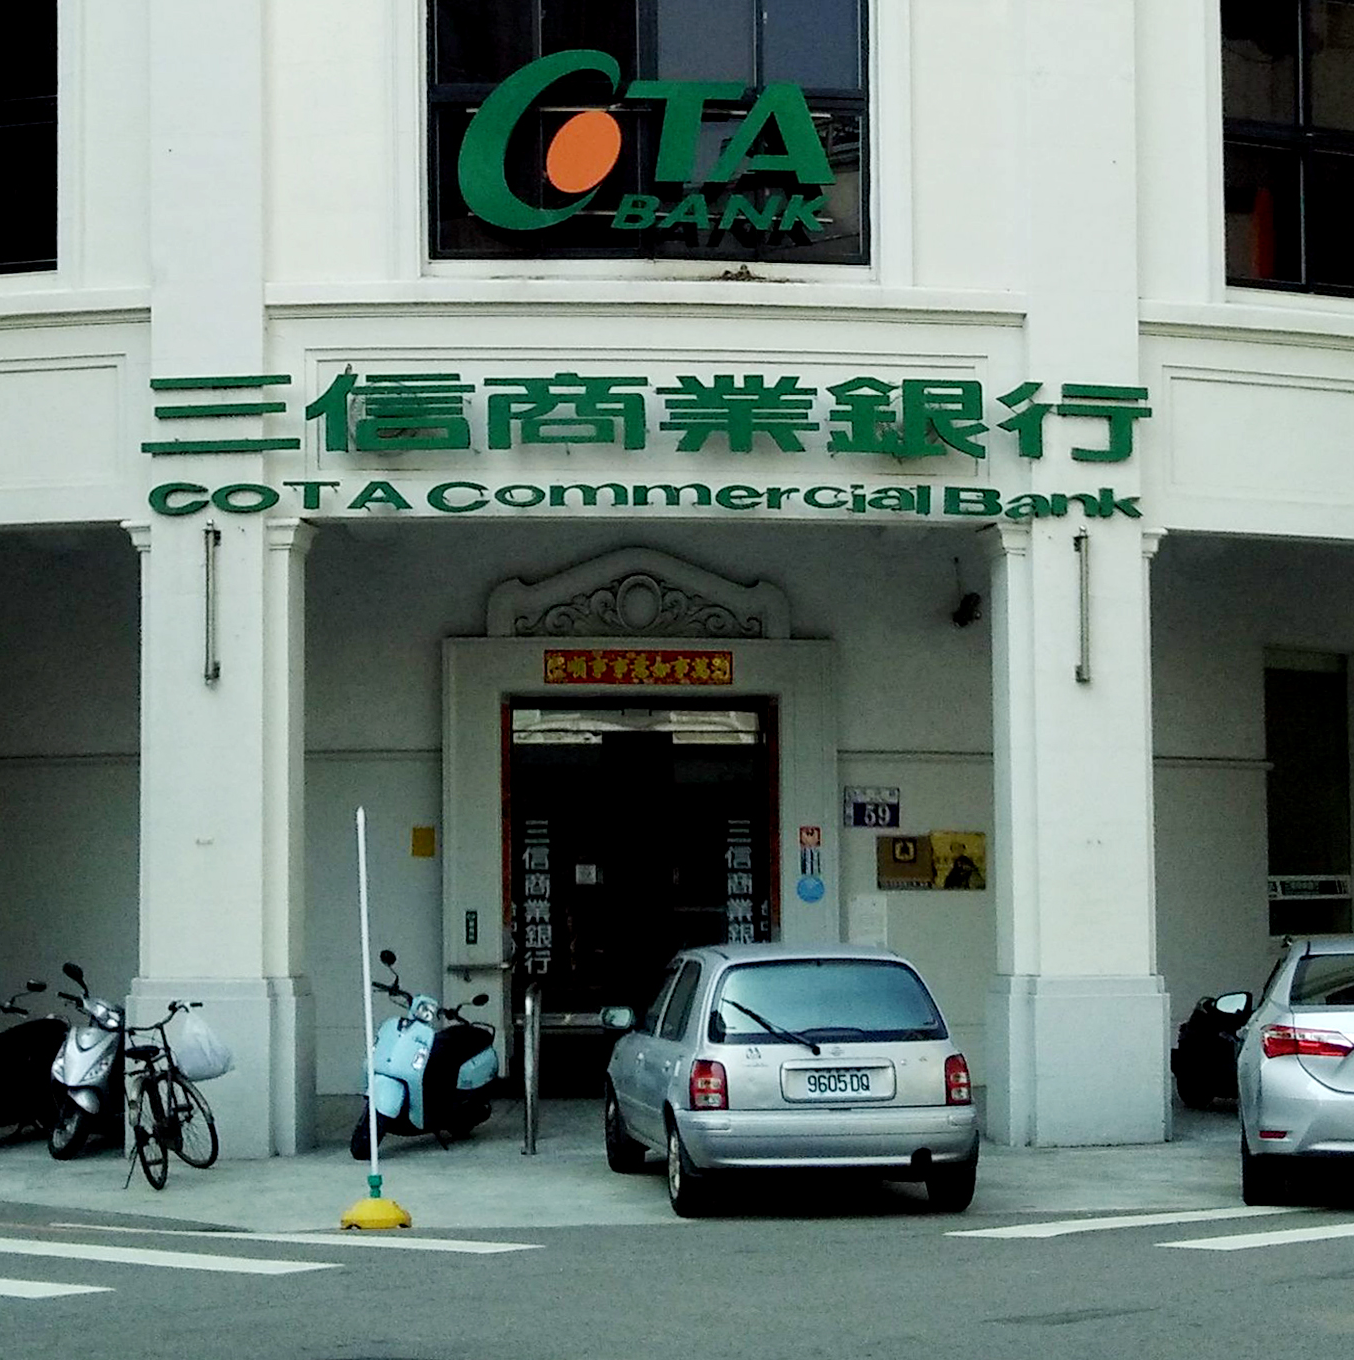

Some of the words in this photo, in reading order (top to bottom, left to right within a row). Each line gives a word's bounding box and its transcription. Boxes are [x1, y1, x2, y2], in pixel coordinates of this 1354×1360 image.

[610, 193, 828, 232] BANK
[141, 371, 1153, 463] 三信商業銀行
[147, 480, 413, 517] COTA
[426, 480, 932, 516] Commercial
[942, 486, 1144, 519] Bank
[863, 804, 891, 826] 59
[522, 819, 552, 975] 三信商業銀行
